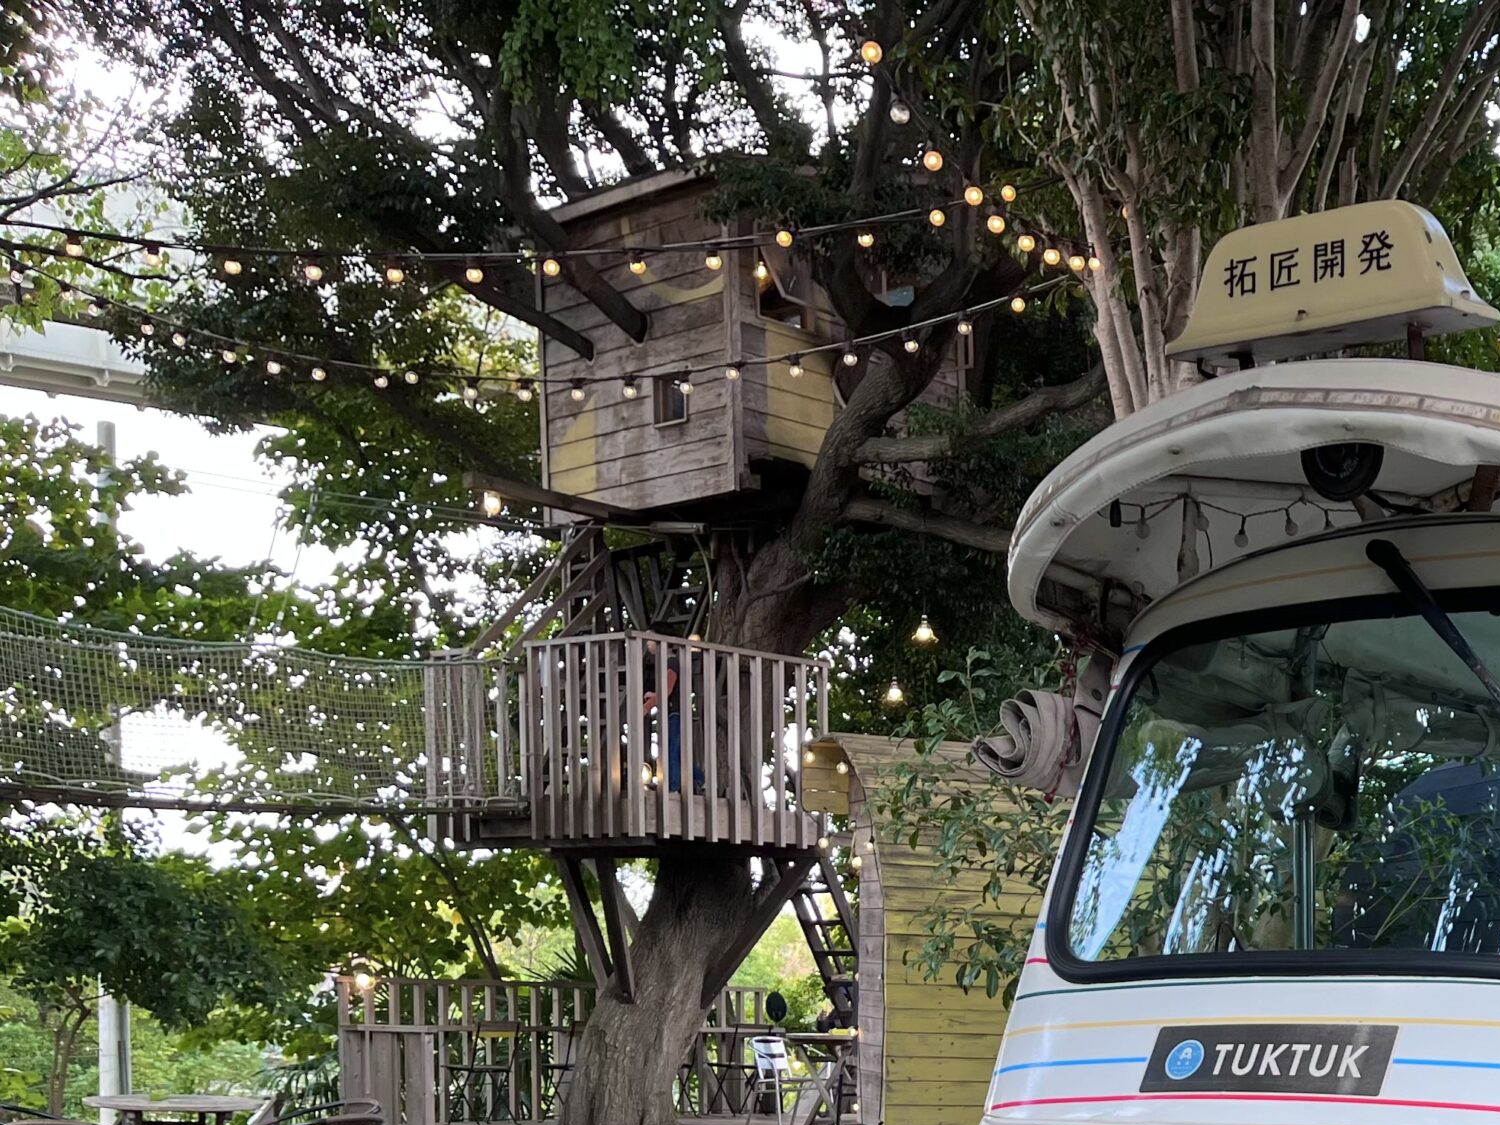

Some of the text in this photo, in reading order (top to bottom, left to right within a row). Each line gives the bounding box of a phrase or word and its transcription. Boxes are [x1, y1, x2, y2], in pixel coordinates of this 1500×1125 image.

[1223, 230, 1394, 298] 拓匠開発
[1212, 1043, 1370, 1078] TUKTUK
